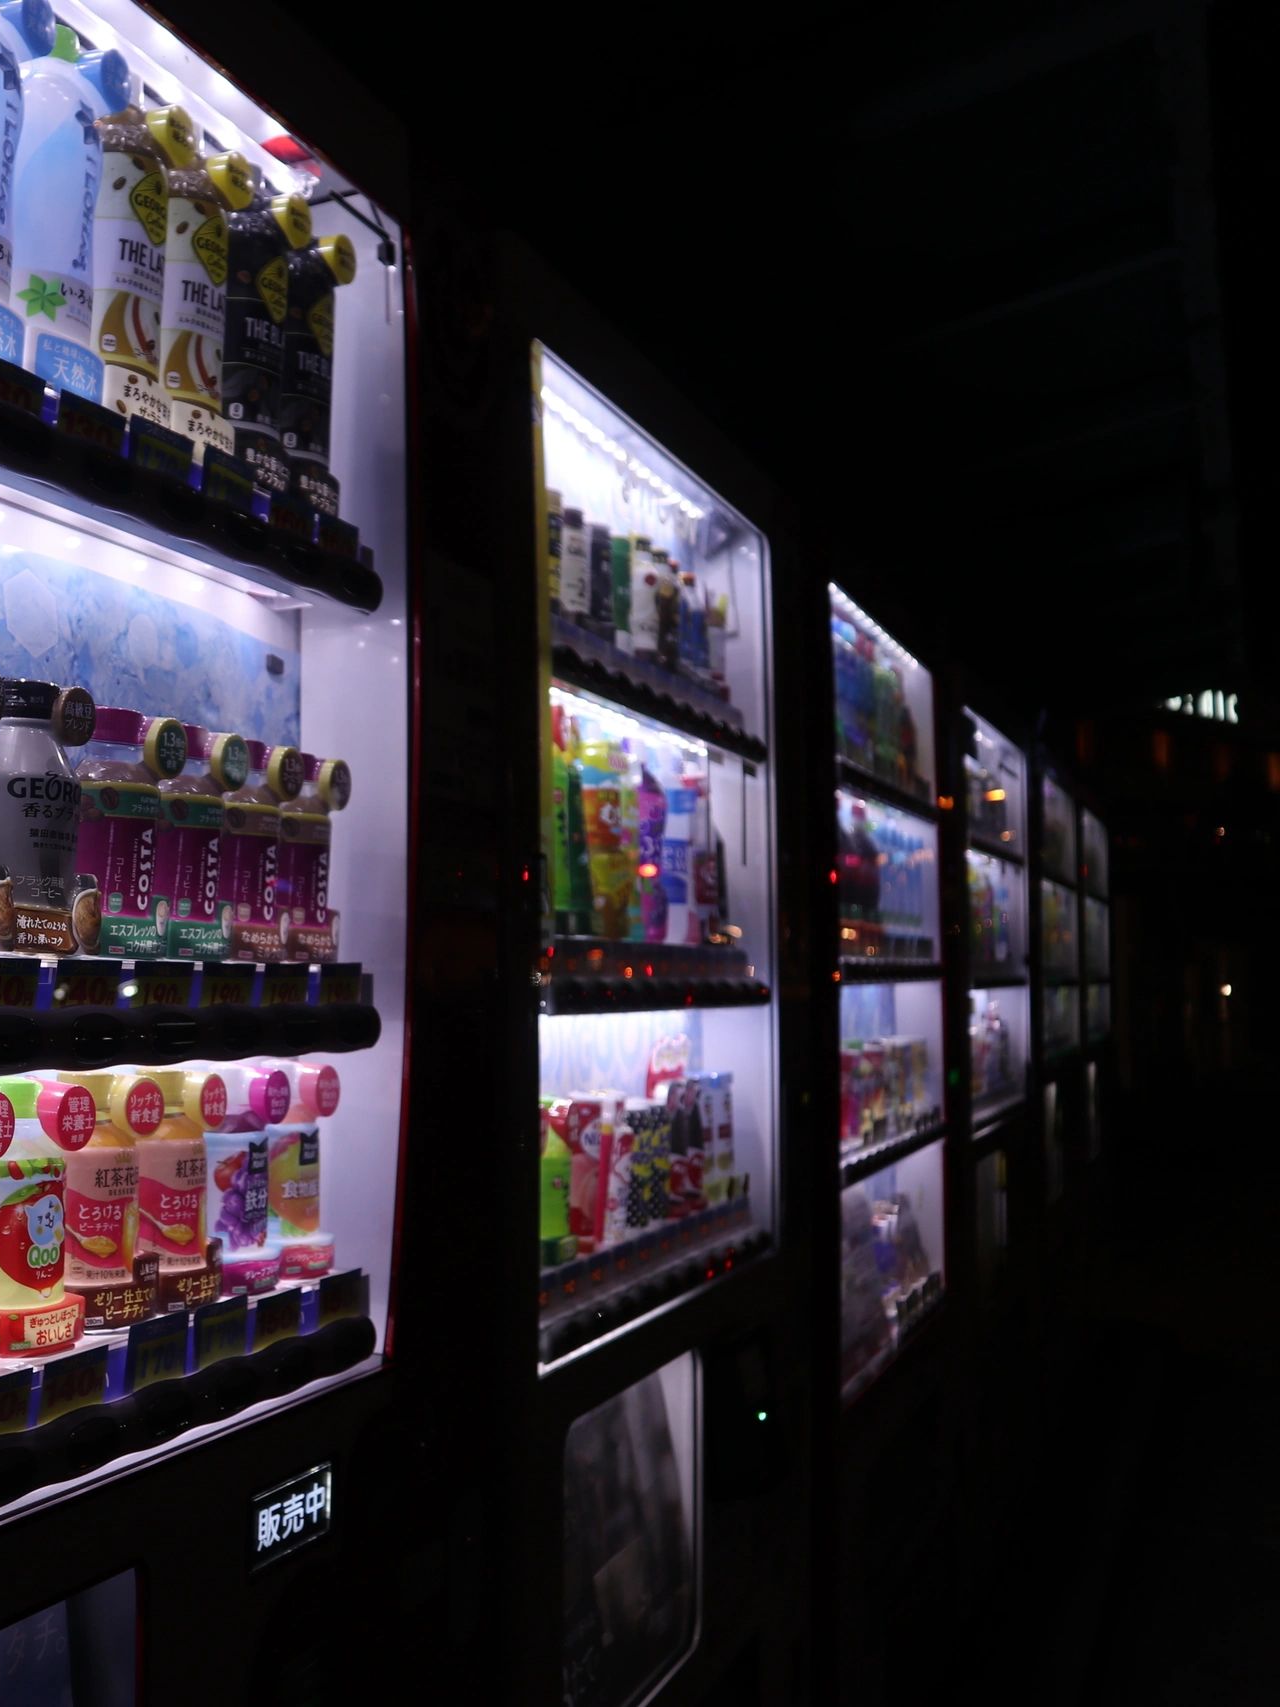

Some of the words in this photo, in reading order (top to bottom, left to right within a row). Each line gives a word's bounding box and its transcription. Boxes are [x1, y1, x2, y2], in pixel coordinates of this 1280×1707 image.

[119, 237, 148, 272] THE
[182, 279, 210, 314] THE
[52, 356, 98, 395] 天然水
[64, 700, 93, 719] 高級豆
[65, 717, 91, 732] ブレンド
[137, 828, 154, 911] COSTA
[203, 837, 220, 915] COSTA
[30, 887, 62, 898] コーヒー
[316, 852, 329, 924] COSTA
[16, 914, 68, 931] 淹れたてのような
[109, 924, 157, 938] エスプレッソの
[16, 932, 64, 948] 香りと深いコク
[69, 1096, 91, 1114] 管理
[129, 1092, 162, 1107] リッチな
[62, 1114, 94, 1133] 栄養士
[130, 1108, 161, 1125] 新食感
[160, 1193, 200, 1212] とろける
[78, 1203, 123, 1222] とろける
[160, 1211, 196, 1222] ピーチティー
[78, 1222, 120, 1233] ピーチティー
[28, 1243, 60, 1268] Qoo
[35, 1267, 54, 1280] りんご
[29, 1307, 78, 1330] ぎゅっとしぼった
[105, 1303, 151, 1321] ピーチティー
[36, 1323, 73, 1346] おいしさ
[257, 1482, 326, 1552] 販売中
